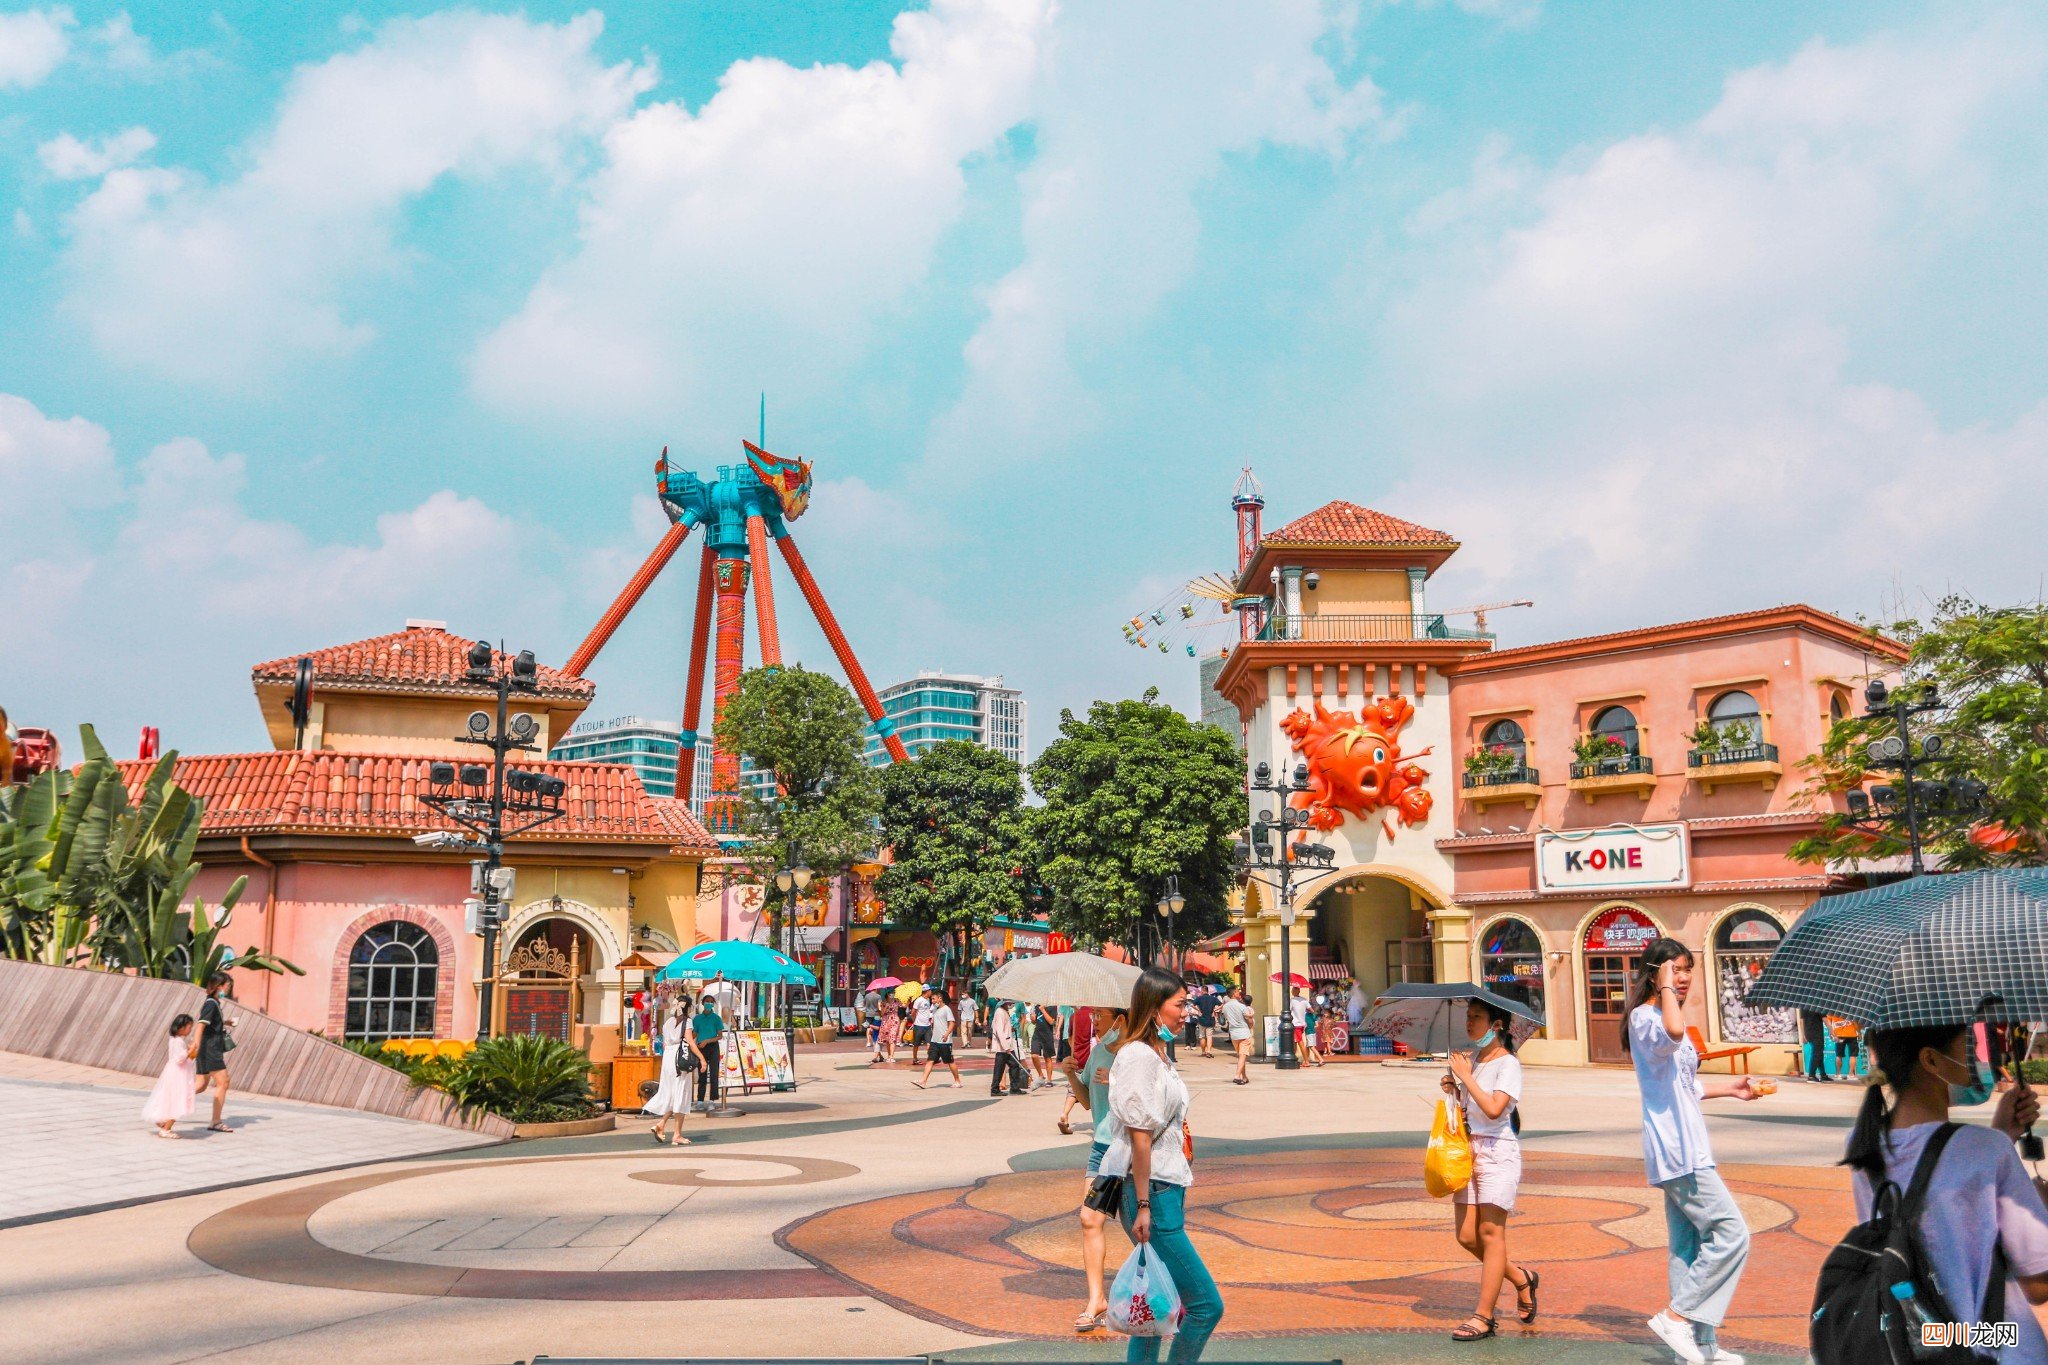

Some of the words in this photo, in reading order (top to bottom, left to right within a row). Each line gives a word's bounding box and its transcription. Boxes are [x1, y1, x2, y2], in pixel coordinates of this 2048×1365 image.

[575, 720, 604, 733] ATOUR
[609, 715, 638, 728] HOTEL
[1565, 847, 1643, 872] K-ONE
[1603, 929, 1626, 940] 快手
